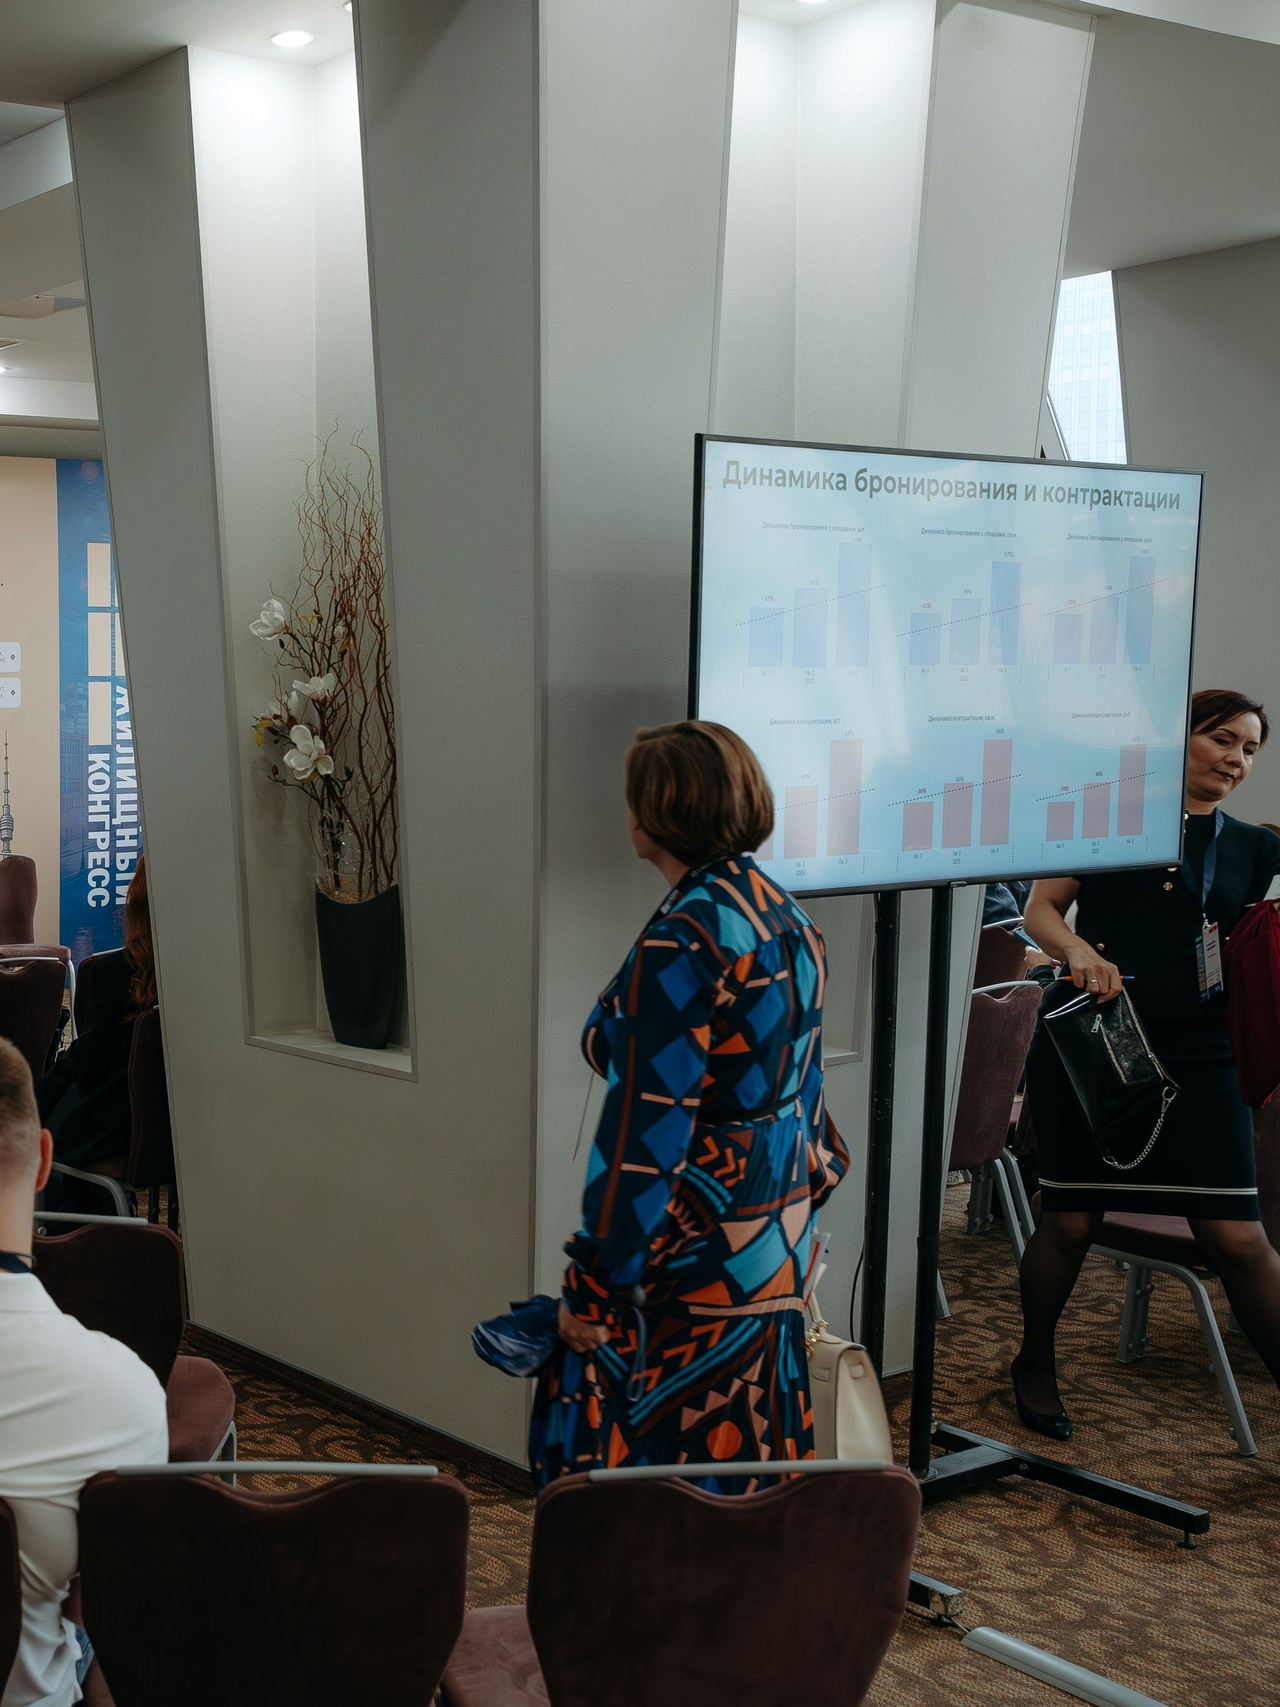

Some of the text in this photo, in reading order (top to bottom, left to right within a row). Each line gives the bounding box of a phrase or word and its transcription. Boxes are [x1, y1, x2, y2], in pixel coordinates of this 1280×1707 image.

[723, 460, 1180, 511] Динамика бронирования и контрактации
[769, 718, 795, 726] Динамика
[87, 753, 110, 908] КОНГРЕСС
[112, 685, 138, 905] ЖИЛИЩНЫ
